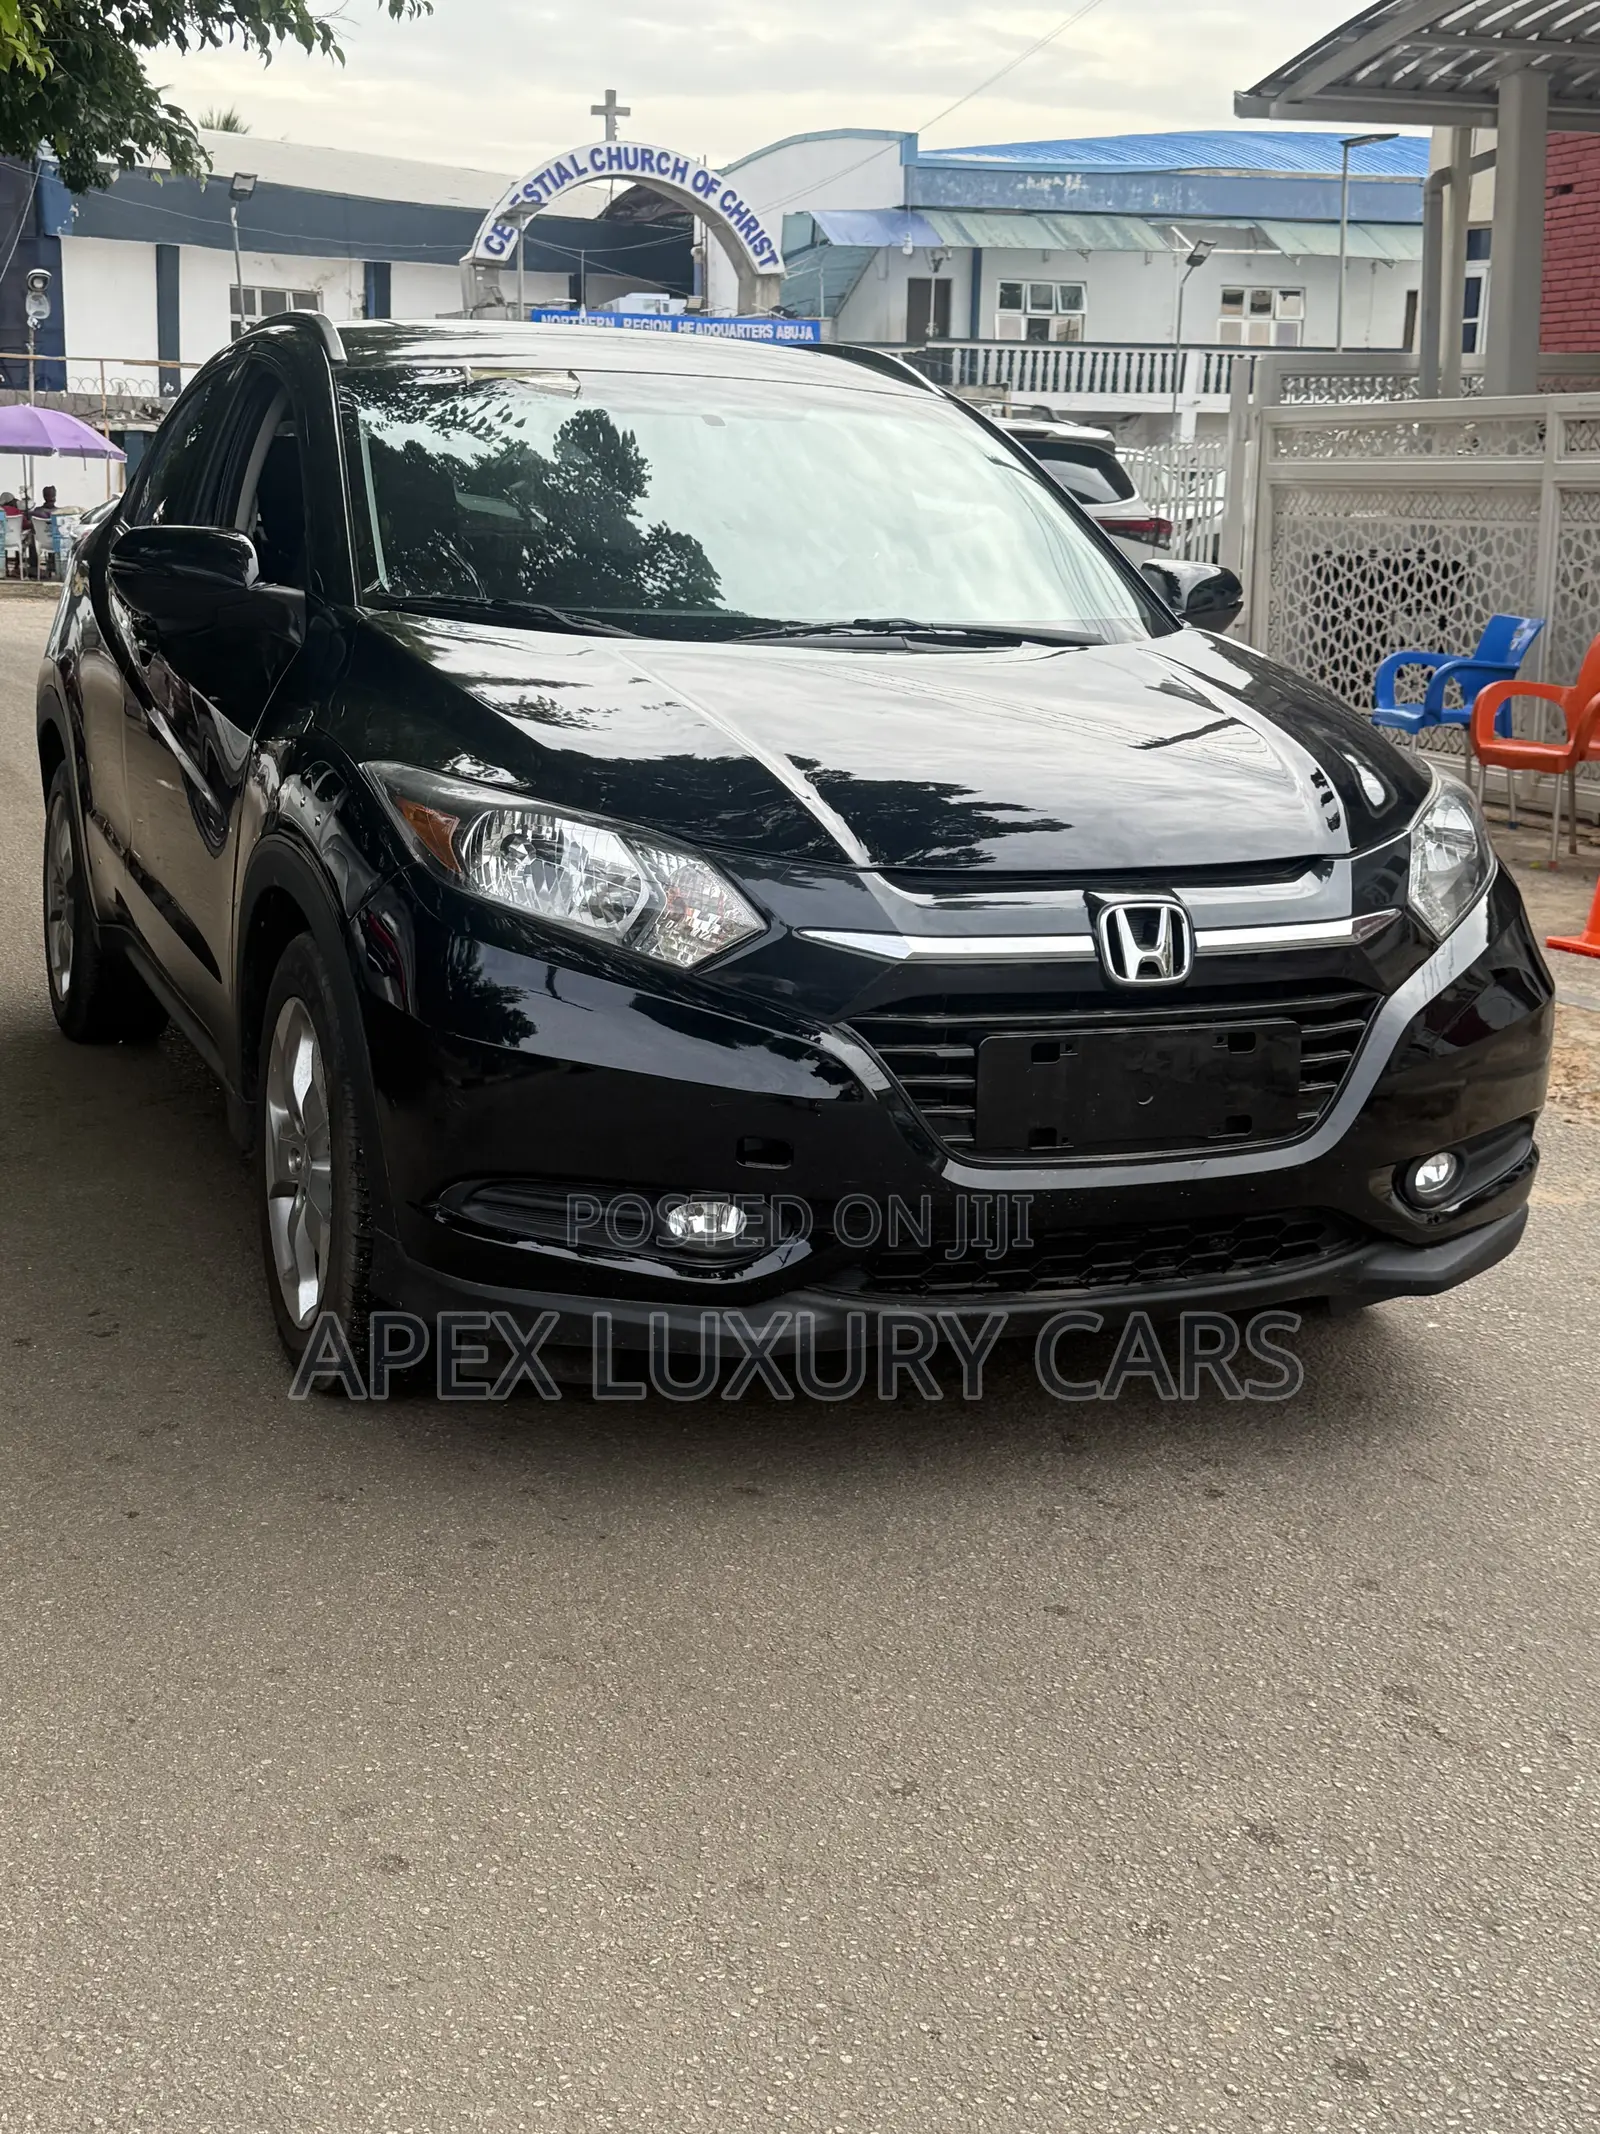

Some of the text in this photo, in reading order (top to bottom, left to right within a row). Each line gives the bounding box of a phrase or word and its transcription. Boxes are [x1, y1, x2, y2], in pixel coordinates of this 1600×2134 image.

[484, 146, 780, 267] CESTIAL CHURCH OF CHRIST
[623, 317, 672, 332] REGION
[677, 320, 774, 339] HEADQUARTERS
[776, 325, 814, 340] ABUJA
